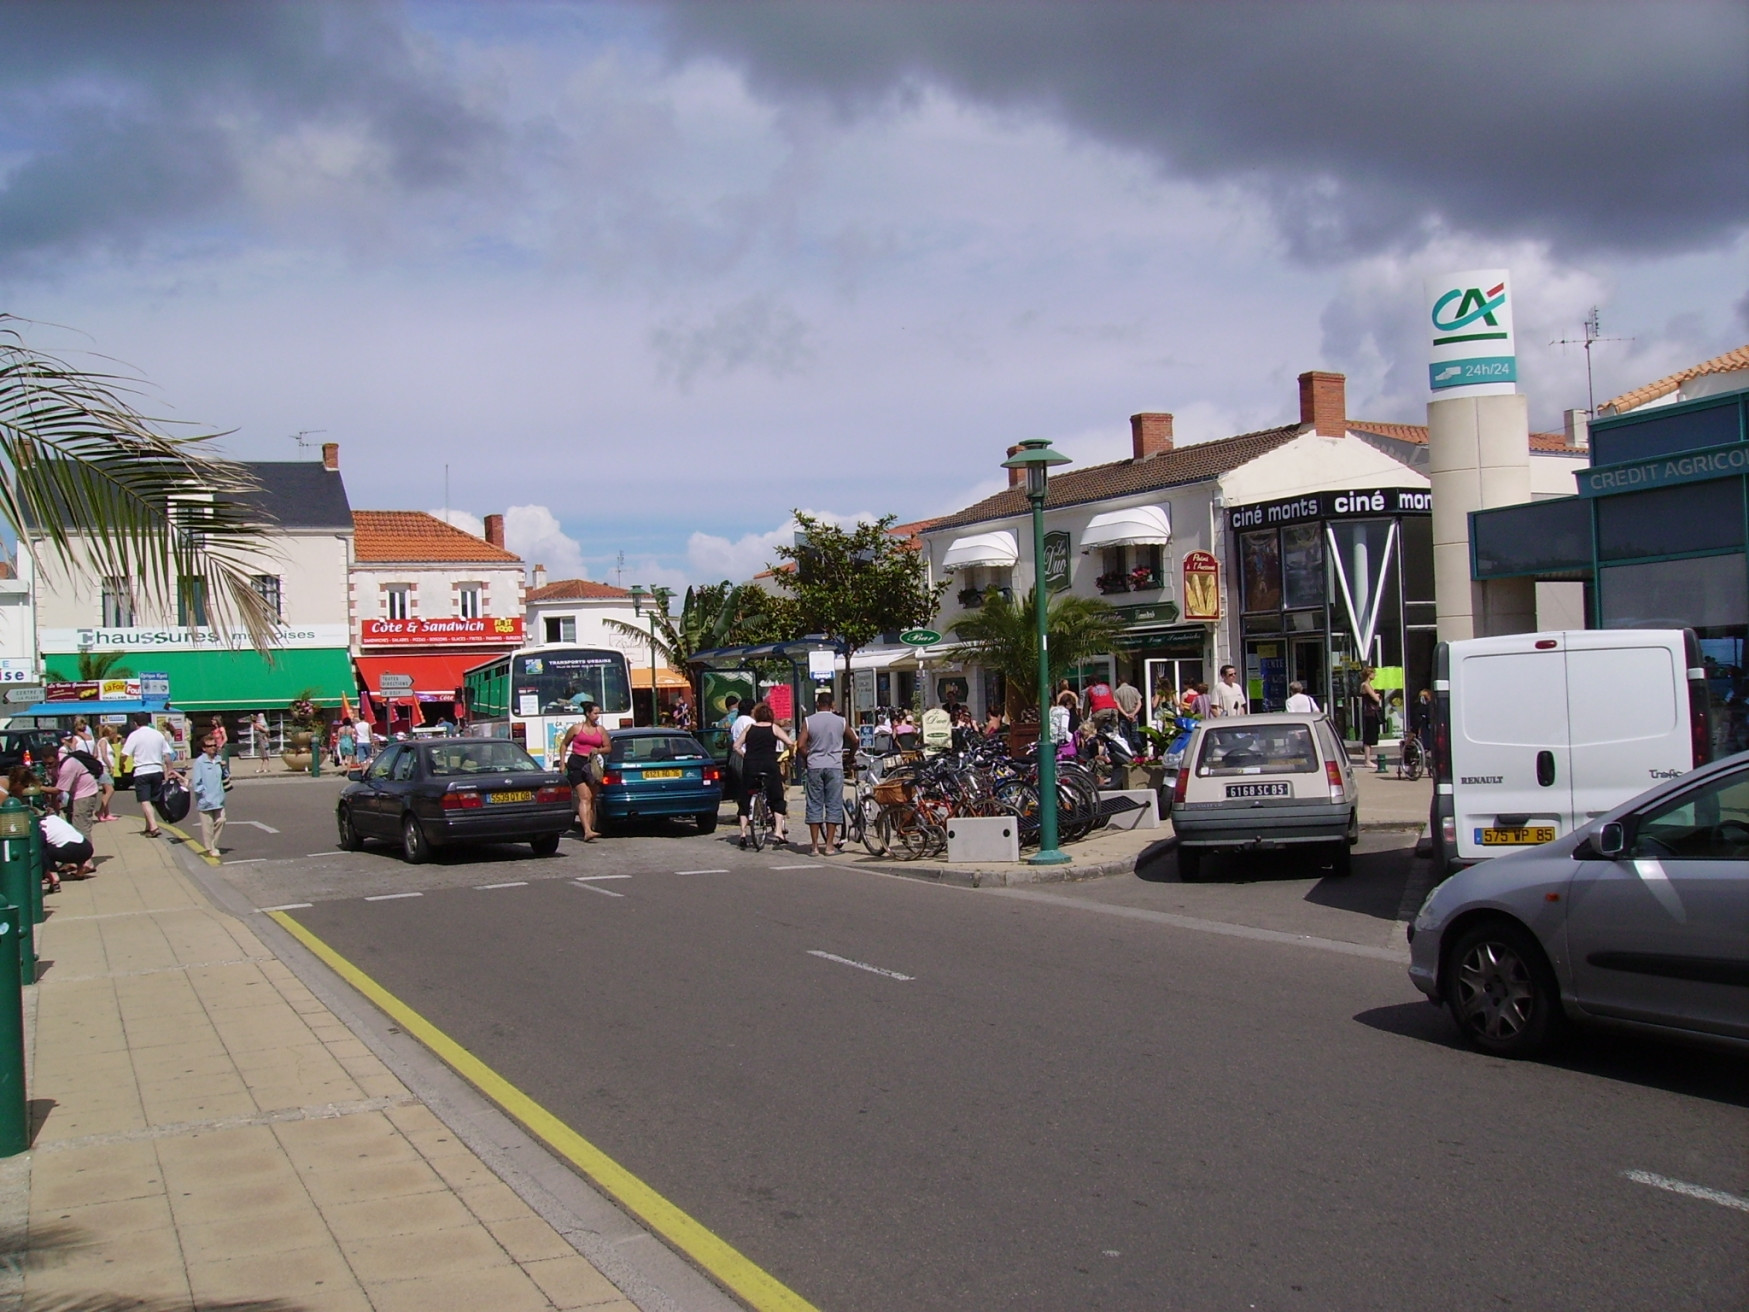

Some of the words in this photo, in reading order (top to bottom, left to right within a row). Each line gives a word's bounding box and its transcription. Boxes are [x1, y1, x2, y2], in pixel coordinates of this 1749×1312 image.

[1465, 363, 1510, 377] 24h/24
[1334, 490, 1385, 513] ciné
[1232, 506, 1263, 528] ciné
[1268, 499, 1318, 522] monts
[406, 621, 418, 634] &
[421, 620, 485, 633] Sandwich
[495, 625, 514, 633] FOOD
[232, 630, 315, 641] moises
[907, 633, 935, 642] Bar
[1461, 776, 1504, 785] RENAULT
[1649, 769, 1684, 779] Trafic
[1230, 785, 1255, 797] 6168
[1257, 785, 1270, 796] SC
[1271, 784, 1284, 795] 85
[1484, 829, 1508, 843] 575
[1537, 828, 1554, 842] 85
